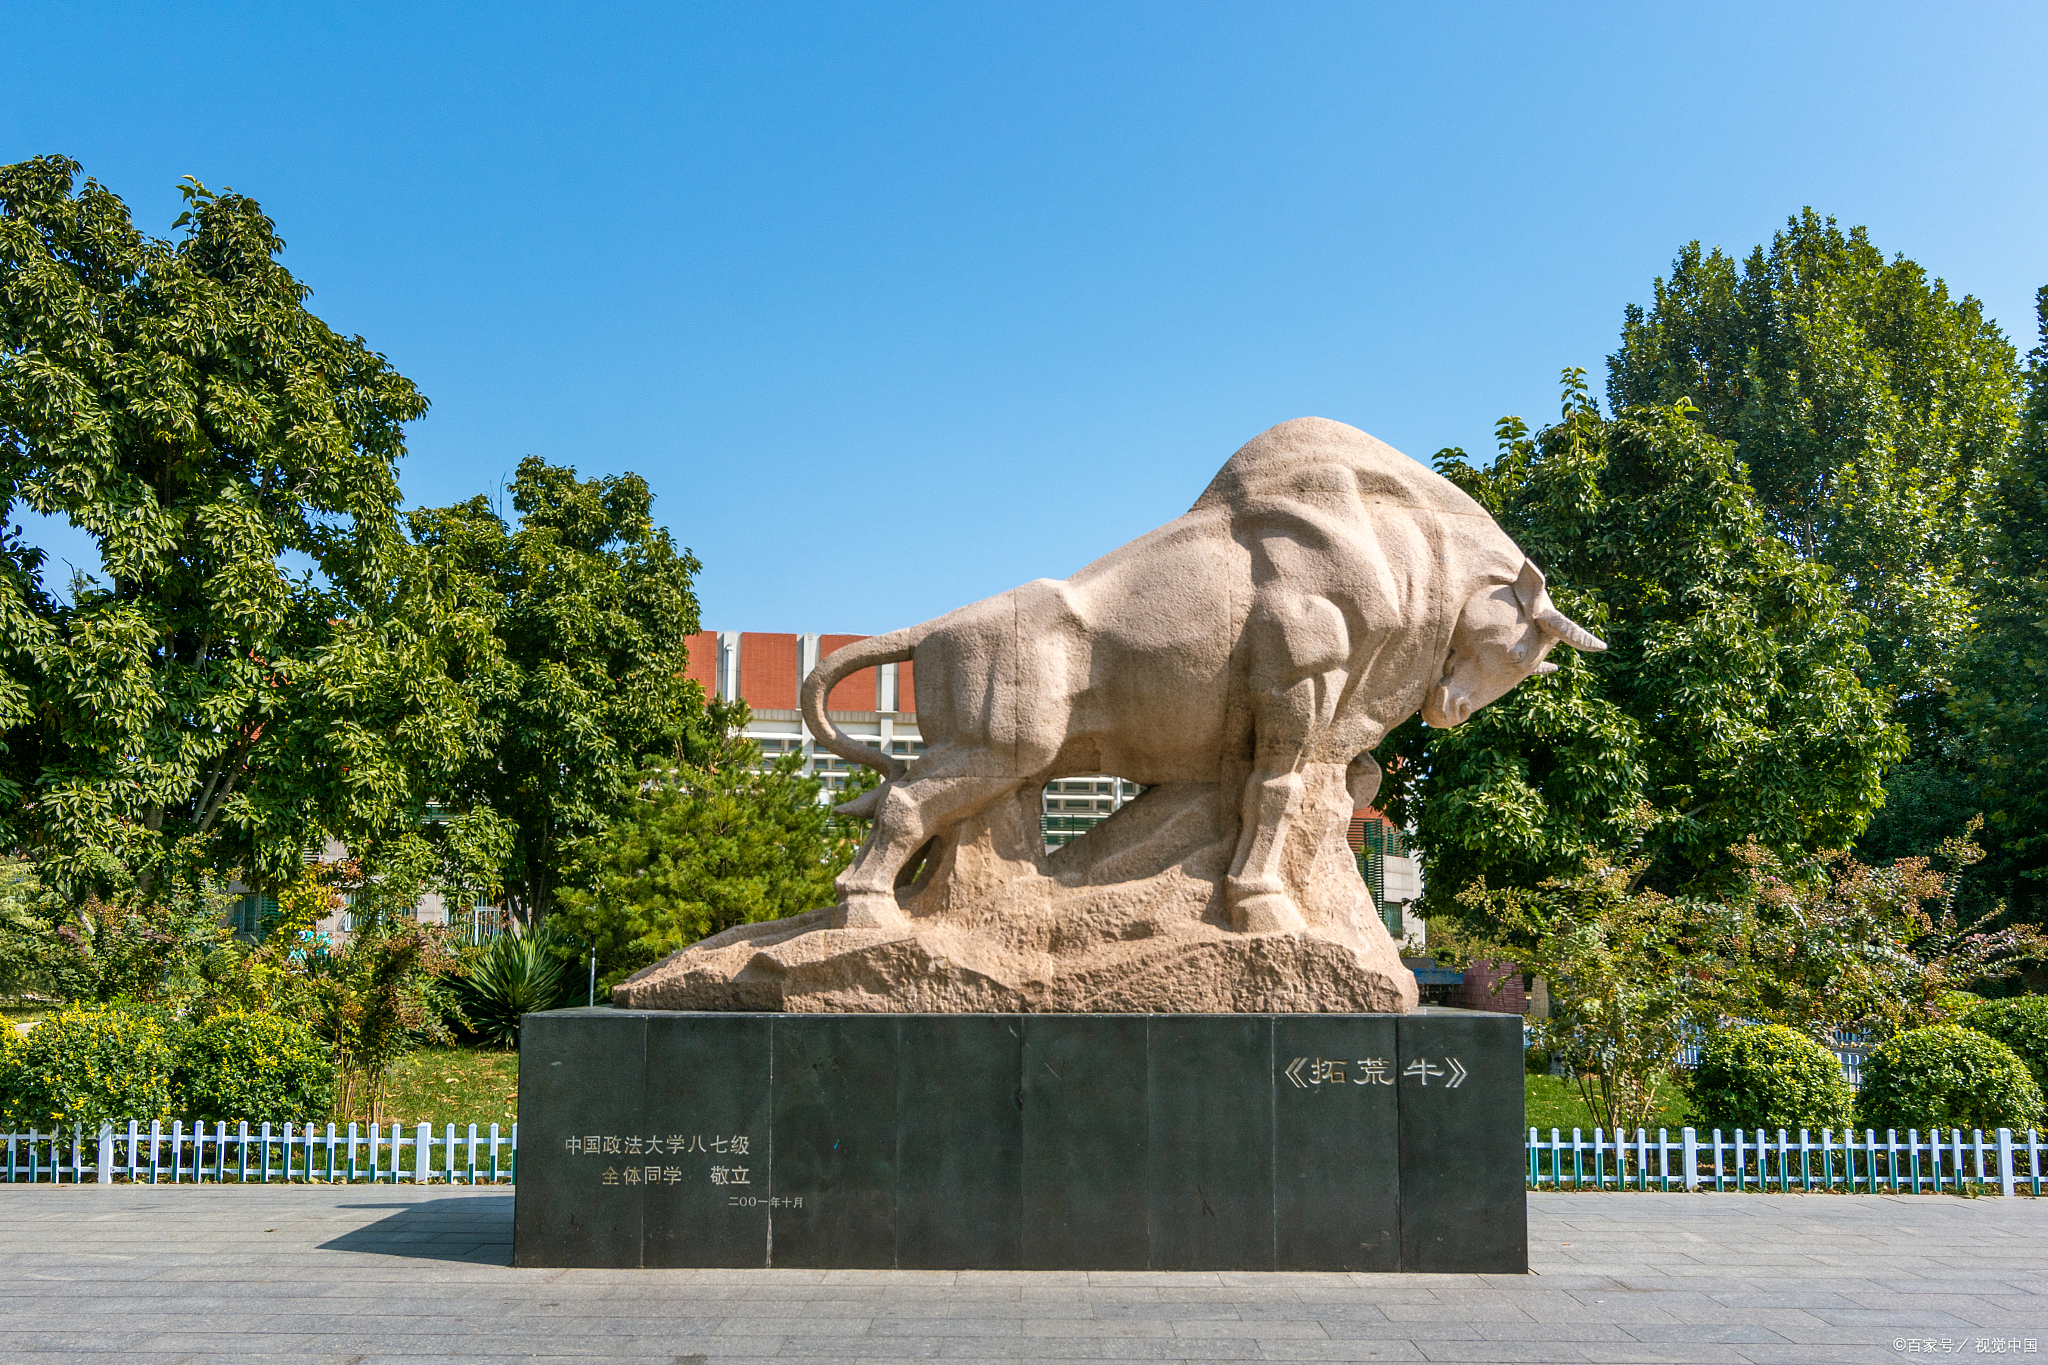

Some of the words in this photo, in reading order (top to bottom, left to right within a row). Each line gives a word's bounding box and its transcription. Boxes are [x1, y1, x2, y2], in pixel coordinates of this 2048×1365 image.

[1284, 1057, 1468, 1088] 《拓荒牛》
[564, 1134, 750, 1155] 中国政法大学八七级
[601, 1165, 683, 1186] 全体同学
[710, 1165, 751, 1186] 敬立
